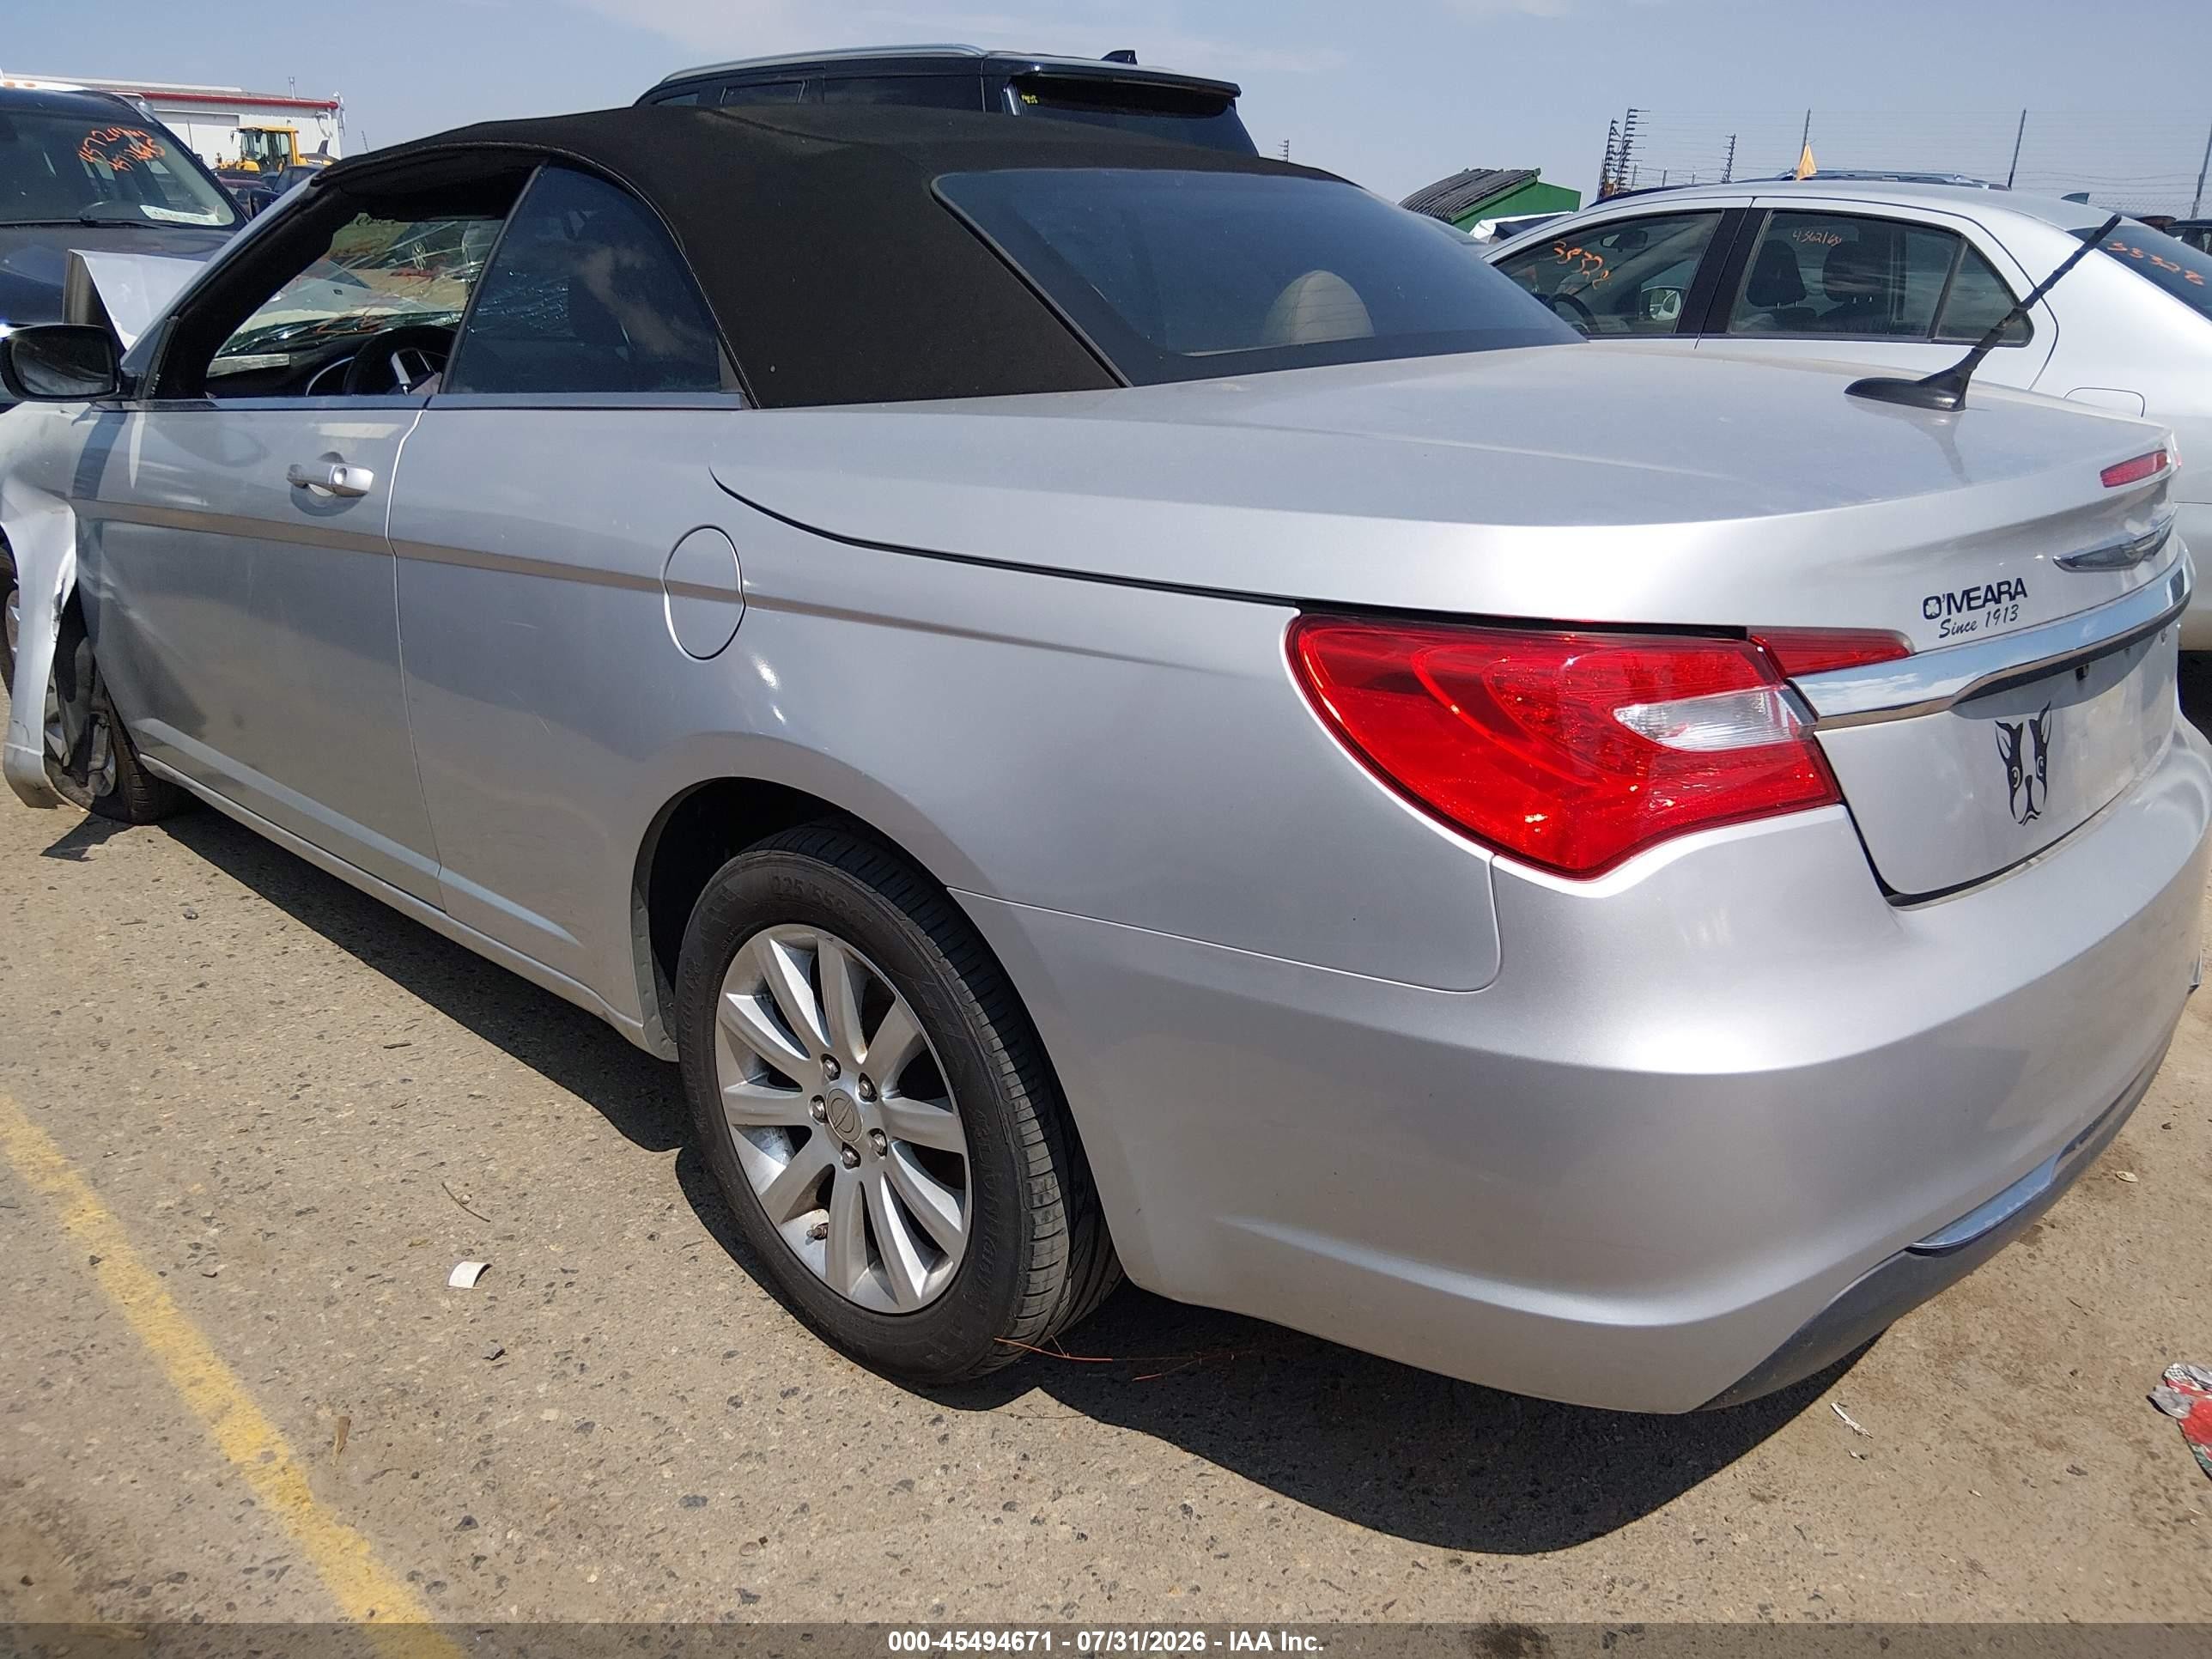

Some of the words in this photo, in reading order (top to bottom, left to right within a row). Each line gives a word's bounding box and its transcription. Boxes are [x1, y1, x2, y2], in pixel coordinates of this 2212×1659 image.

[1923, 577, 2028, 620] O'MEARA
[1939, 618, 1978, 639] Since
[1985, 604, 2019, 628] 1913
